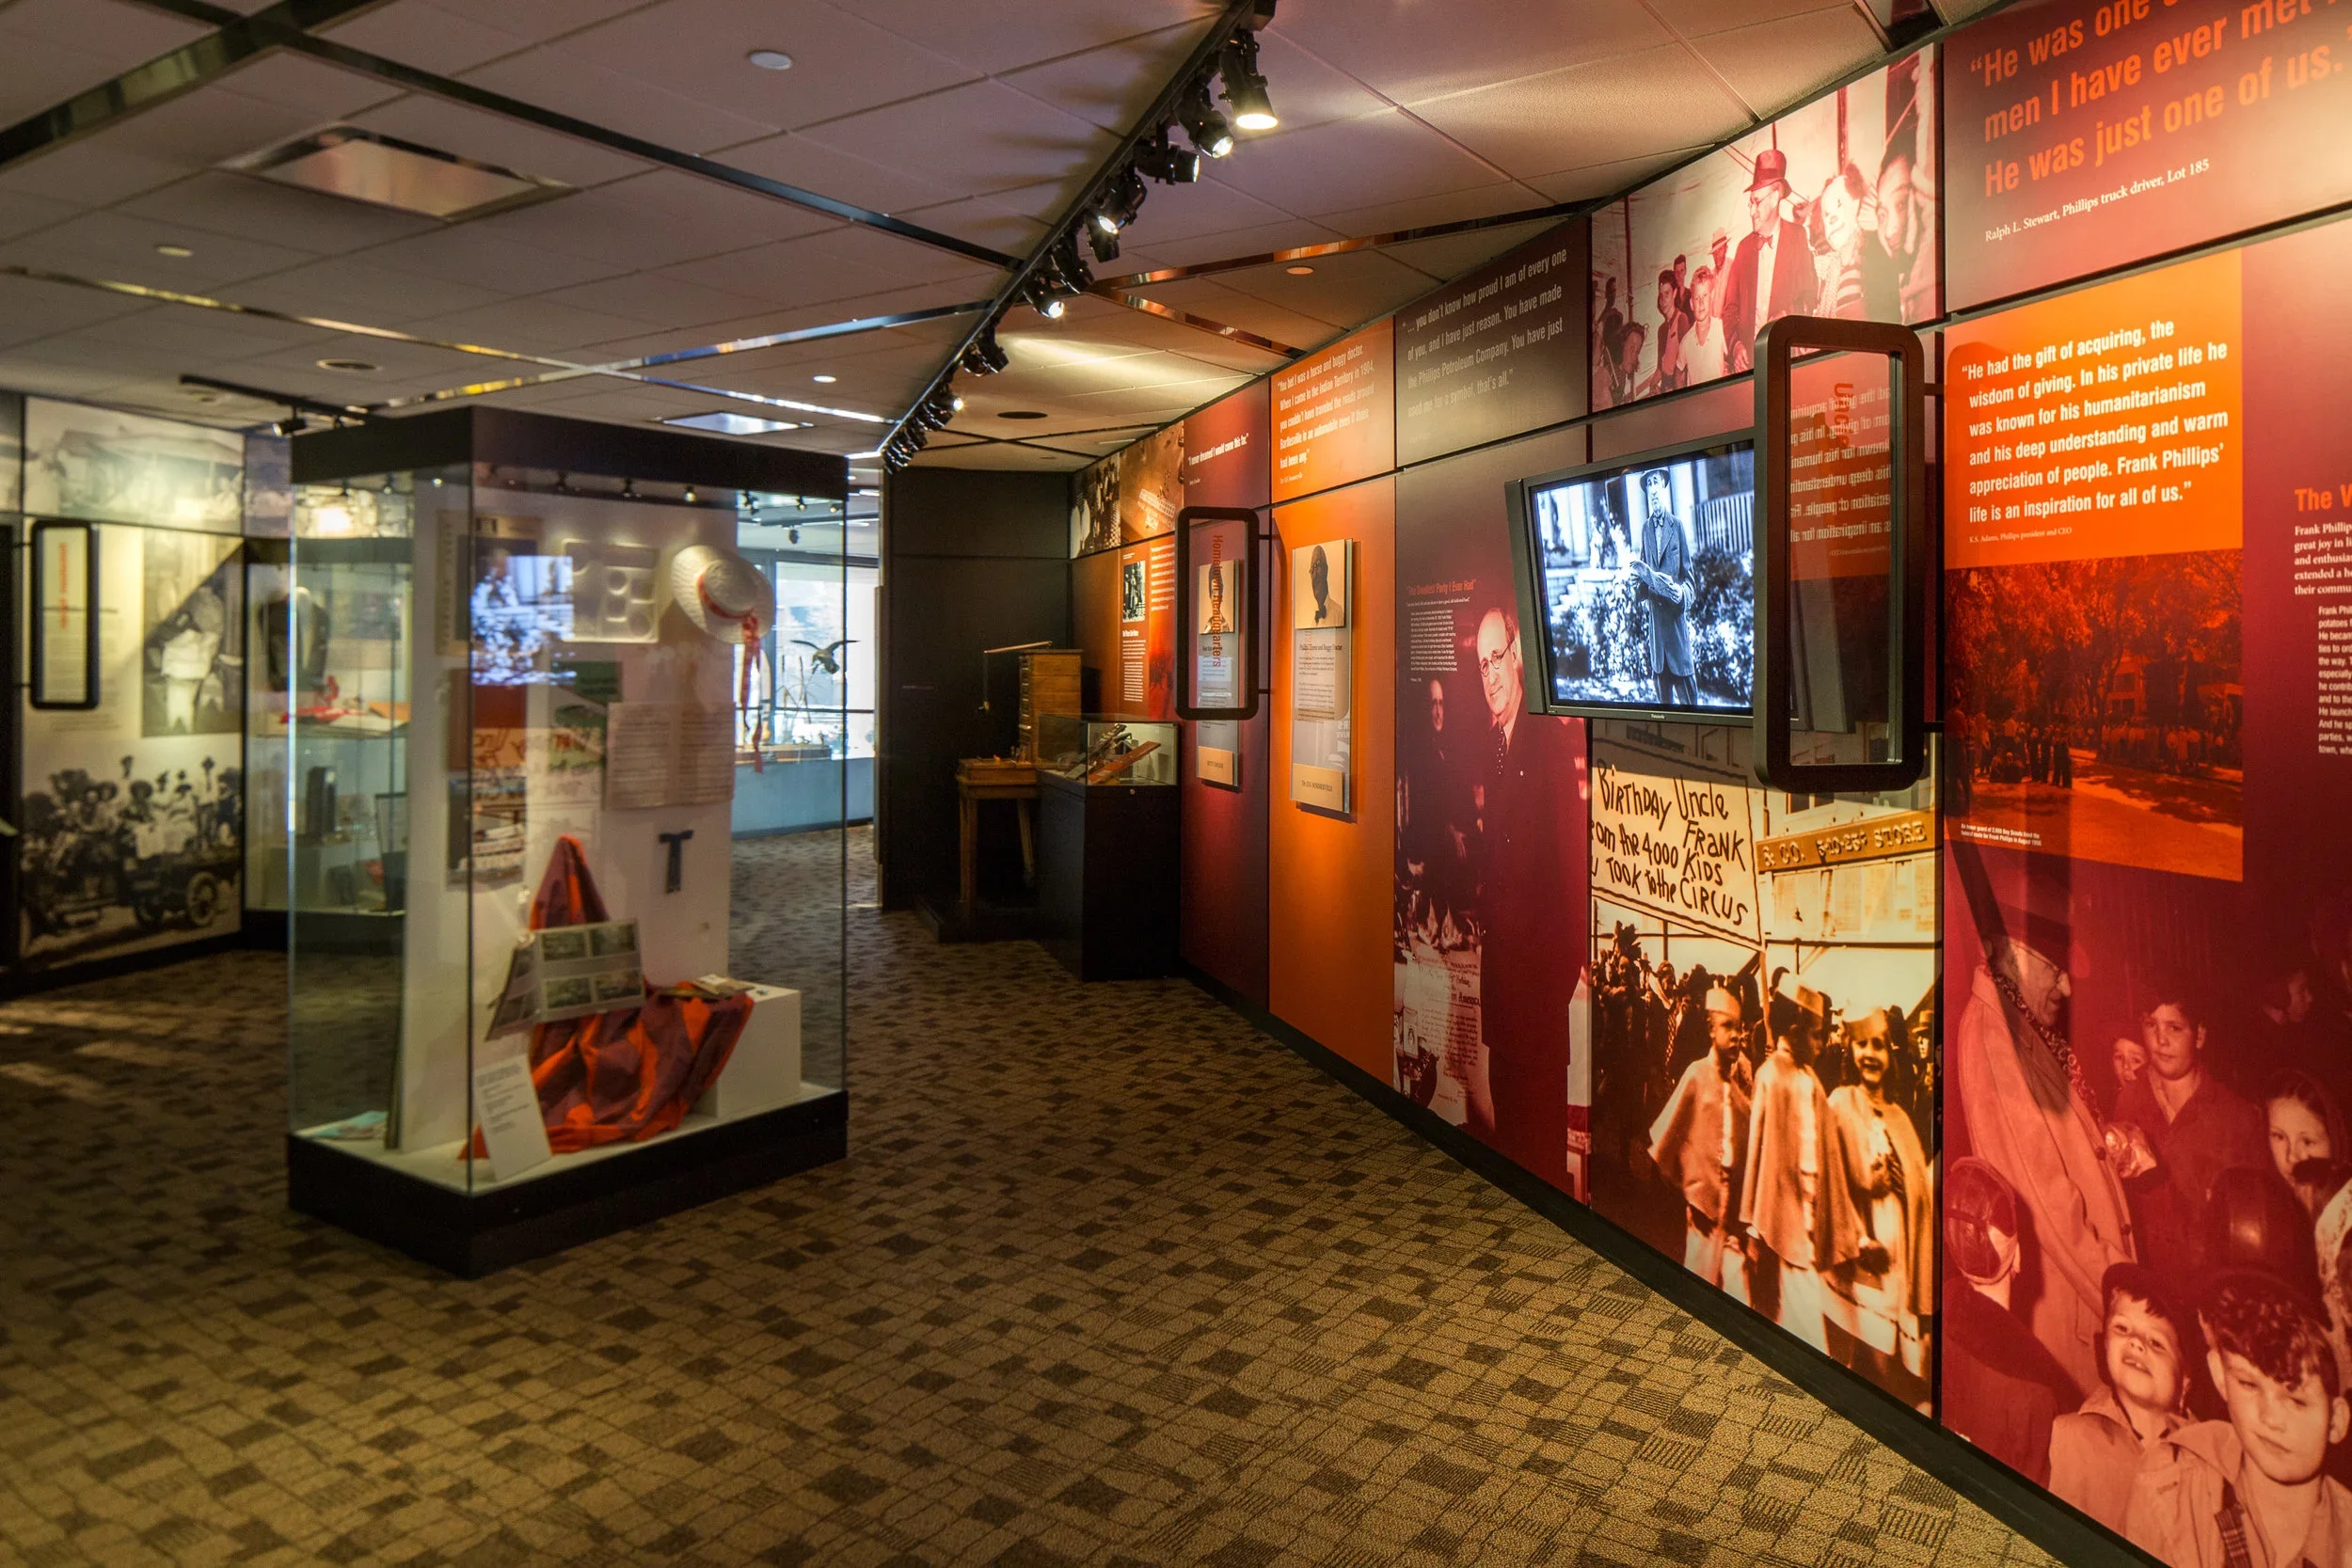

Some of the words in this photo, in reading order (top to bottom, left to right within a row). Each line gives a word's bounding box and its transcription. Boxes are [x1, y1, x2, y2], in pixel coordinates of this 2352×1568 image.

[1970, 48, 2019, 87] “He
[2028, 19, 2084, 66] was
[2095, 0, 2151, 37] one
[1985, 96, 2040, 142] men
[2051, 79, 2059, 116] I
[2071, 55, 2141, 108] have
[2153, 17, 2228, 73] ever
[1986, 159, 2020, 198] He
[2028, 136, 2085, 181] was
[2095, 105, 2152, 167] just
[2164, 85, 2225, 133] one
[2238, 55, 2273, 106] of
[1985, 225, 2010, 242] Ralph
[2012, 222, 2022, 234] L.
[2024, 210, 2060, 230] Stewart,
[2062, 196, 2099, 217] Phillips
[2101, 185, 2128, 204] truck
[2130, 176, 2165, 195] driver,
[2168, 166, 2186, 183] Lot
[2189, 158, 2210, 176] 185
[1416, 314, 1427, 332] you
[1444, 297, 1461, 315] know
[1463, 291, 1477, 308] how
[1478, 277, 1499, 304] proud
[1504, 272, 1517, 288] am
[1518, 264, 1526, 281] of
[1528, 257, 1549, 277] every
[1551, 248, 1567, 267] one
[1407, 345, 1414, 361] of
[1428, 335, 1440, 352] and
[1445, 329, 1461, 345] have
[1462, 321, 1475, 342] just
[1476, 312, 1502, 332] reason.
[1503, 304, 1518, 321] You
[1519, 296, 1538, 314] have
[1539, 283, 1562, 306] made
[1963, 364, 1983, 380] “He
[1987, 356, 2010, 376] had
[2012, 353, 2032, 371] the
[2035, 345, 2057, 369] gift
[2059, 340, 2074, 360] of
[2077, 328, 2146, 356] acquiring,
[2150, 320, 2174, 340] the
[1419, 367, 1440, 385] Phillips
[1442, 354, 1474, 377] Petroleum
[1511, 334, 1525, 350] You
[1526, 326, 1546, 345] have
[1547, 316, 1564, 341] just
[1969, 388, 2014, 409] wisdom
[2017, 380, 2030, 399] of
[2033, 375, 2076, 400] giving.
[2080, 368, 2093, 387] In
[2097, 363, 2119, 383] his
[2122, 353, 2173, 382] private
[2178, 345, 2202, 367] life
[2207, 341, 2228, 361] he
[1834, 383, 1853, 450] Uncle
[1969, 420, 1993, 437] was
[1995, 413, 2034, 433] known
[2038, 408, 2057, 425] for
[2060, 403, 2080, 421] his
[2084, 381, 2205, 417] humanitarianism
[1969, 448, 1991, 466] and
[1994, 444, 2012, 462] his
[2015, 441, 2045, 459] deep
[2050, 423, 2146, 454] understanding
[2151, 416, 2179, 438] and
[2184, 411, 2228, 433] warm
[1969, 471, 2043, 497] appreciation
[2046, 467, 2059, 484] of
[2063, 460, 2112, 486] people.
[2117, 452, 2158, 475] Frank
[2162, 441, 2224, 469] Phillips’
[1969, 506, 1987, 523] life
[1991, 504, 2001, 521] is
[2005, 504, 2020, 519] an
[2024, 495, 2091, 519] inspiration
[2095, 491, 2116, 509] for
[2120, 487, 2137, 507] all
[2141, 484, 2156, 504] of
[2161, 481, 2192, 503] us.”
[2295, 486, 2332, 512] The
[2294, 540, 2316, 553] great
[2318, 539, 2332, 552] joy
[2334, 537, 2344, 548] in
[2295, 524, 2320, 536] Frank
[1213, 535, 1223, 592] Hometown
[2294, 554, 2312, 565] and
[2294, 568, 2334, 580] extended
[2336, 570, 2342, 578] a
[2294, 584, 2316, 595] their
[1673, 775, 1728, 820] Uncle
[1619, 823, 1640, 856] the
[1643, 832, 1678, 868] 4000
[1779, 841, 1806, 863] CO.
[1873, 820, 1927, 847] STORE
